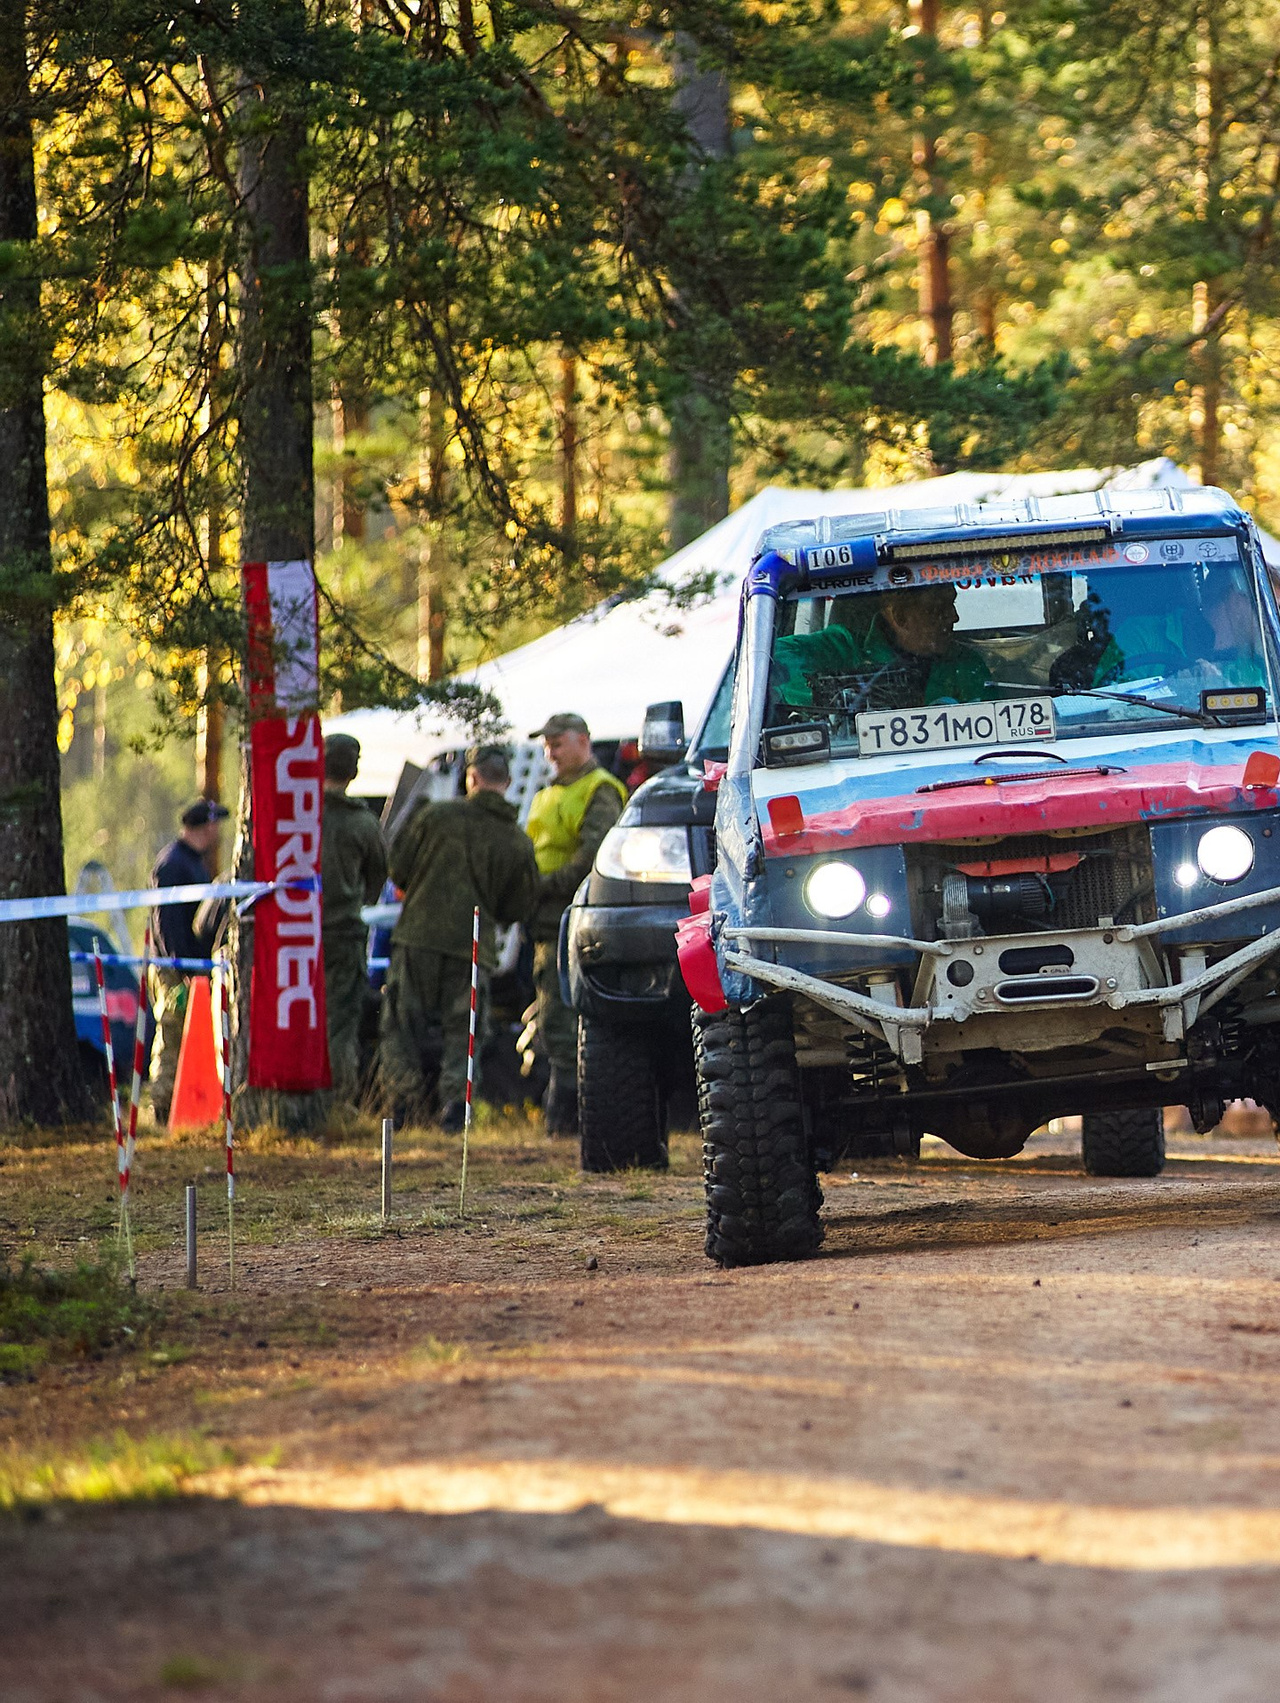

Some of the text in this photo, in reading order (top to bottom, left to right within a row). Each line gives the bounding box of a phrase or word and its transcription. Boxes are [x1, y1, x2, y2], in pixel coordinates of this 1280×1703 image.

[811, 546, 850, 568] 106
[998, 702, 1044, 728] 178
[1011, 726, 1034, 737] RUS
[276, 706, 322, 1030] SUPROTEC
